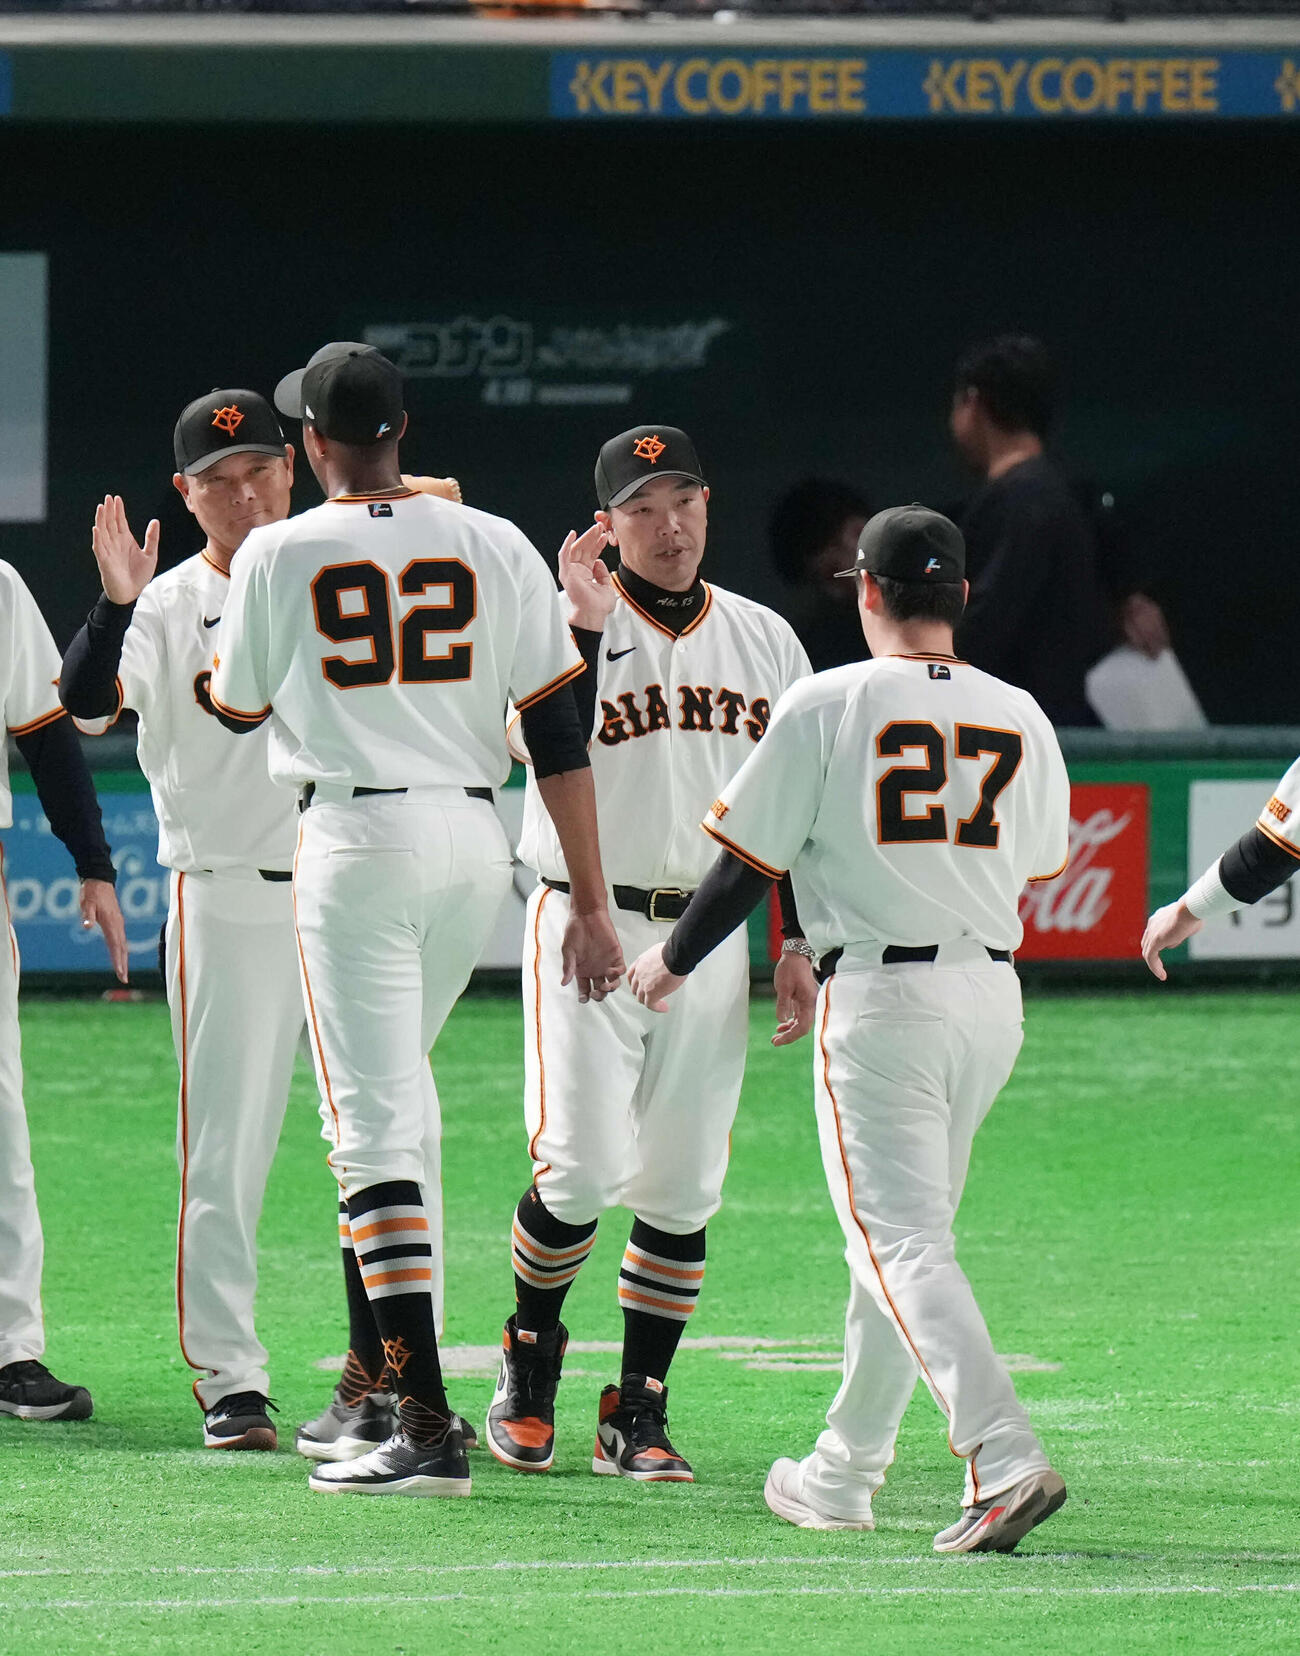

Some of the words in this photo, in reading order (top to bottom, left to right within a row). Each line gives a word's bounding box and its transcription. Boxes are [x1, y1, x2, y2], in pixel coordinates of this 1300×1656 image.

[309, 557, 477, 691] 92
[597, 683, 771, 746] GIANTS
[875, 720, 1023, 849] 27
